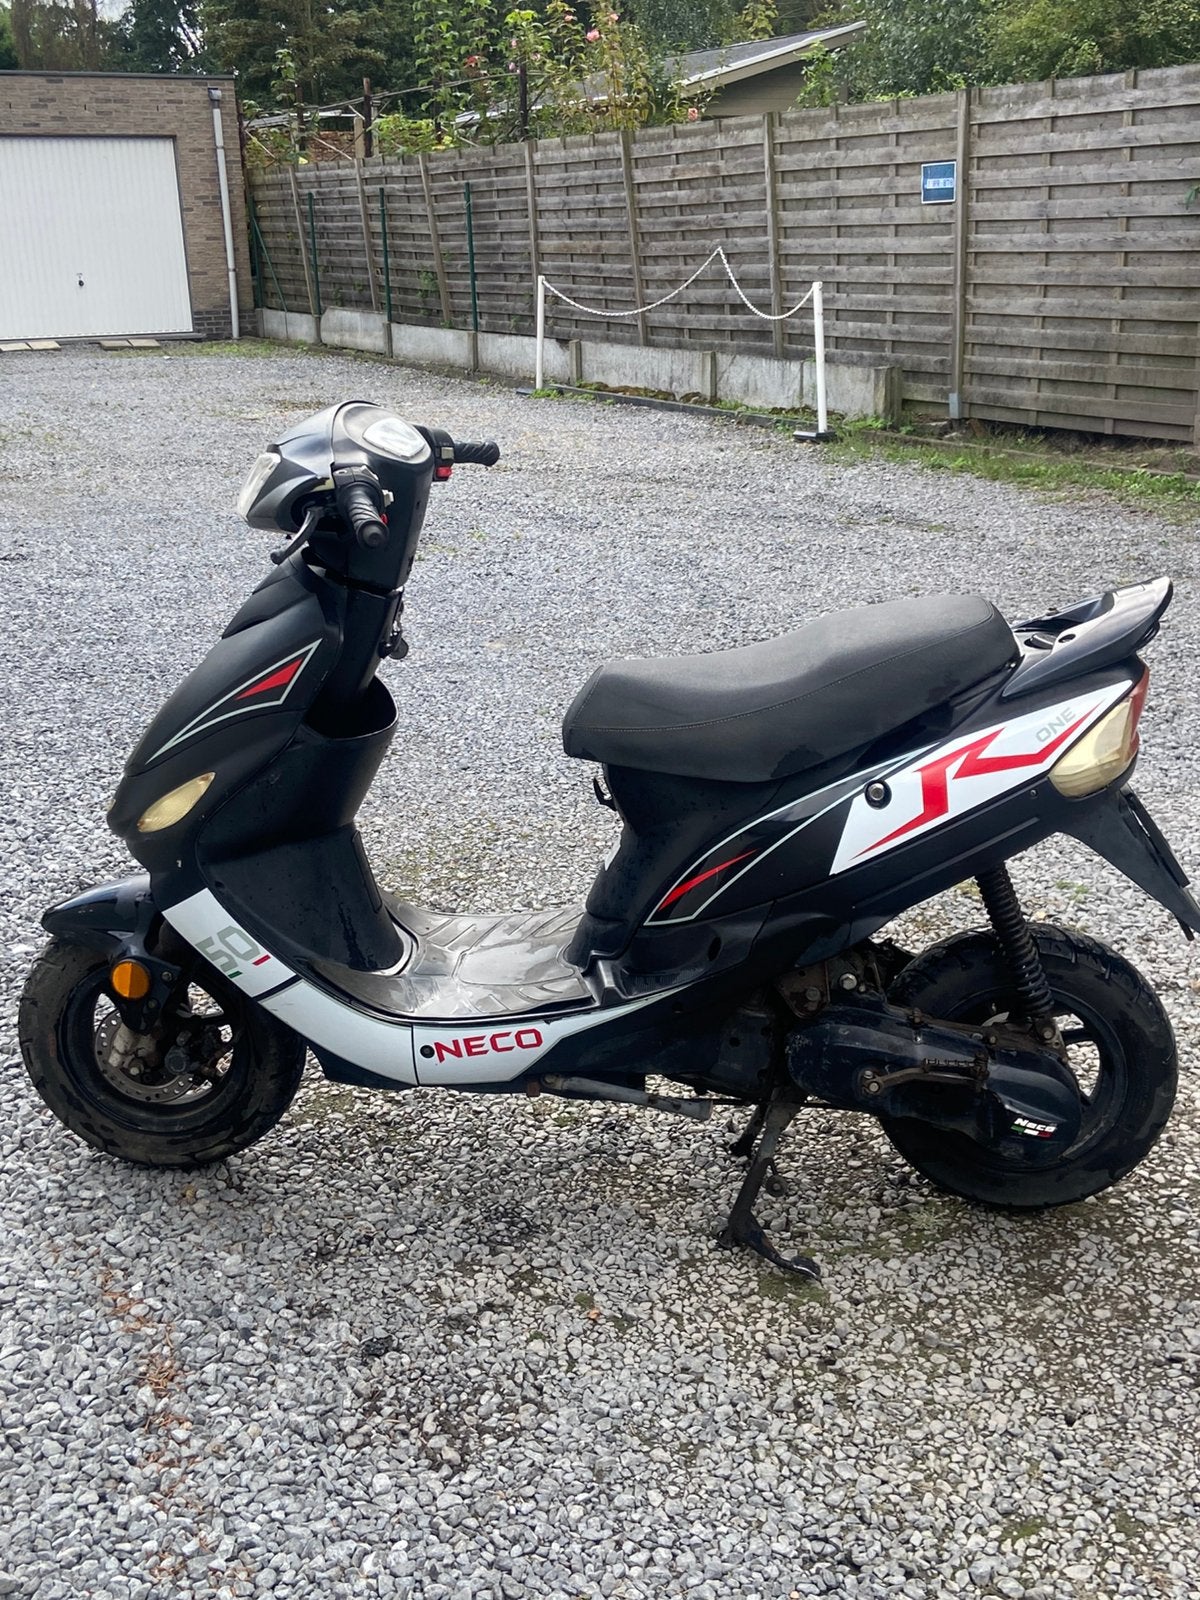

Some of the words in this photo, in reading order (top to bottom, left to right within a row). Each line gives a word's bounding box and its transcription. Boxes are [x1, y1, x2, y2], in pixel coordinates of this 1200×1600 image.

[1035, 707, 1076, 742] ONE
[195, 925, 260, 972] 50
[434, 1028, 543, 1063] NECO
